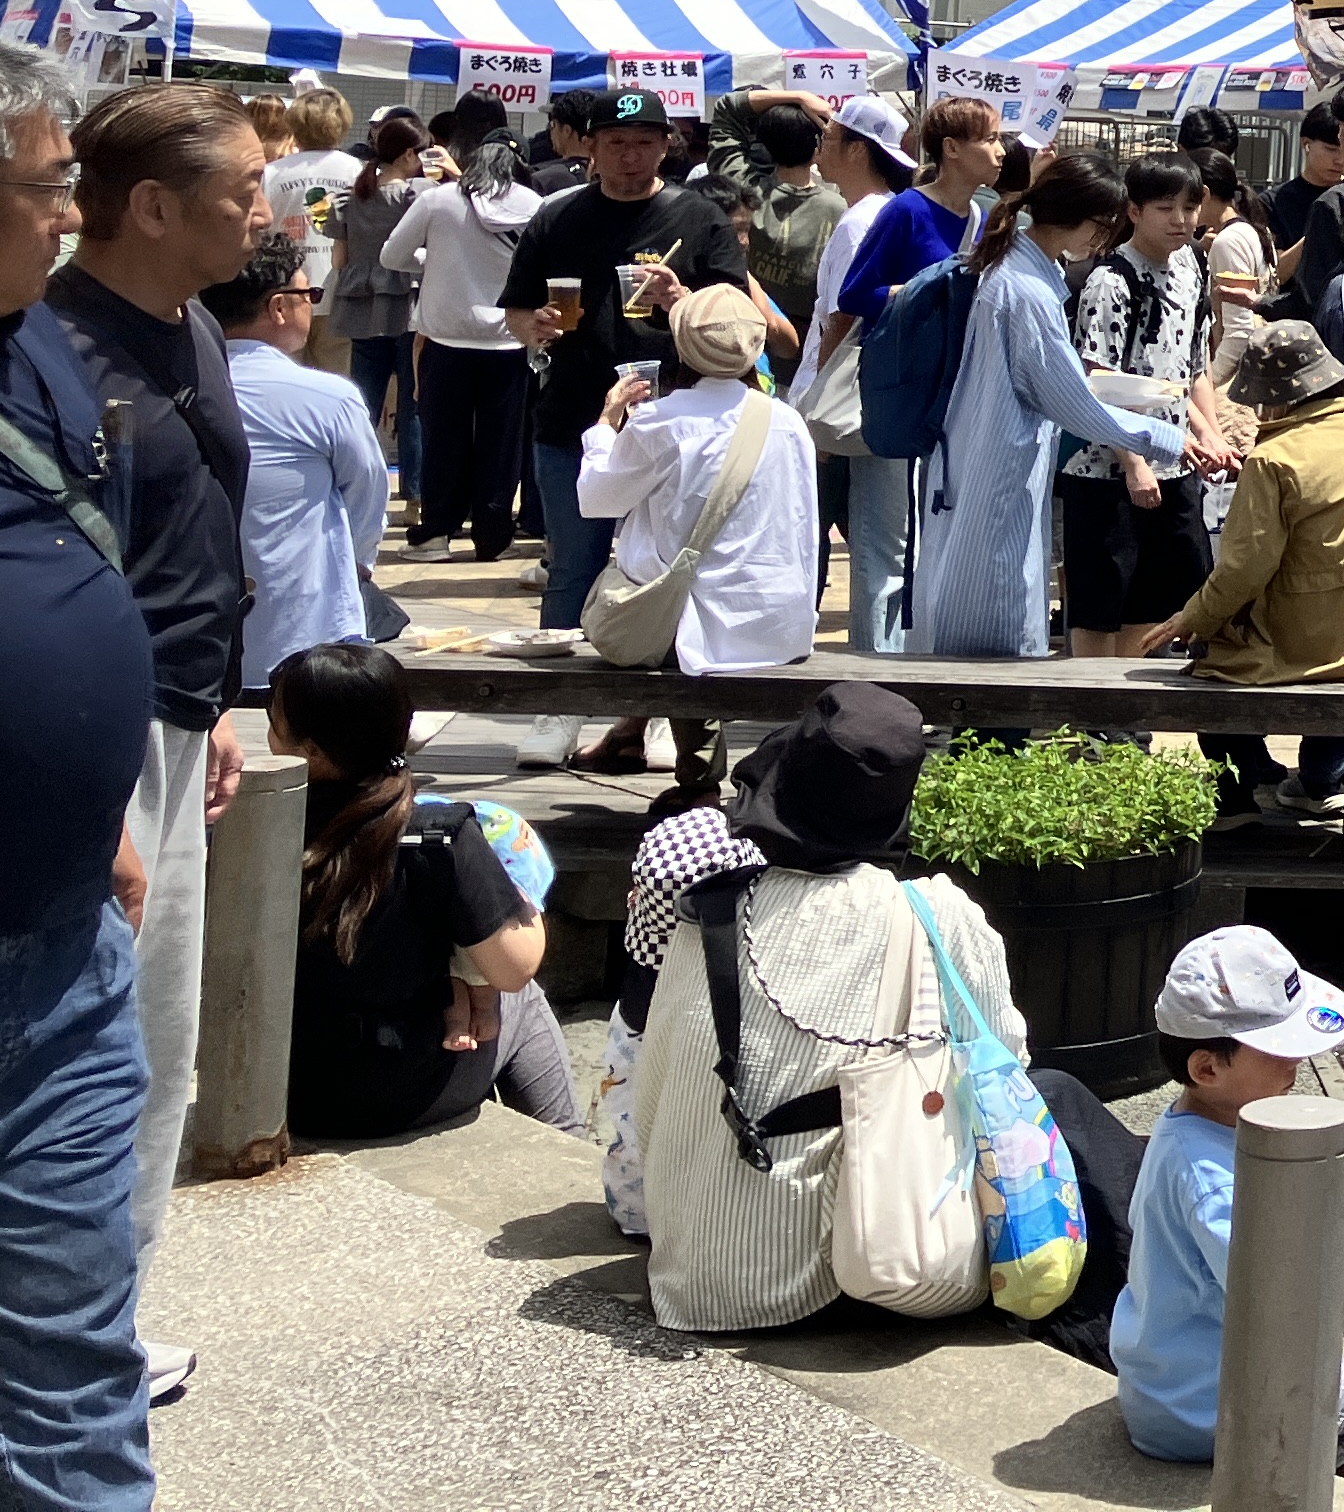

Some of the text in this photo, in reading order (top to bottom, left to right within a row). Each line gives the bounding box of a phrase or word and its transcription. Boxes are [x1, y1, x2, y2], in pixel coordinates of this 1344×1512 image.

[470, 54, 543, 74] まぐろ焼き
[621, 61, 699, 78] 焼き牡蠣
[936, 65, 1022, 94] まぐろ焼き
